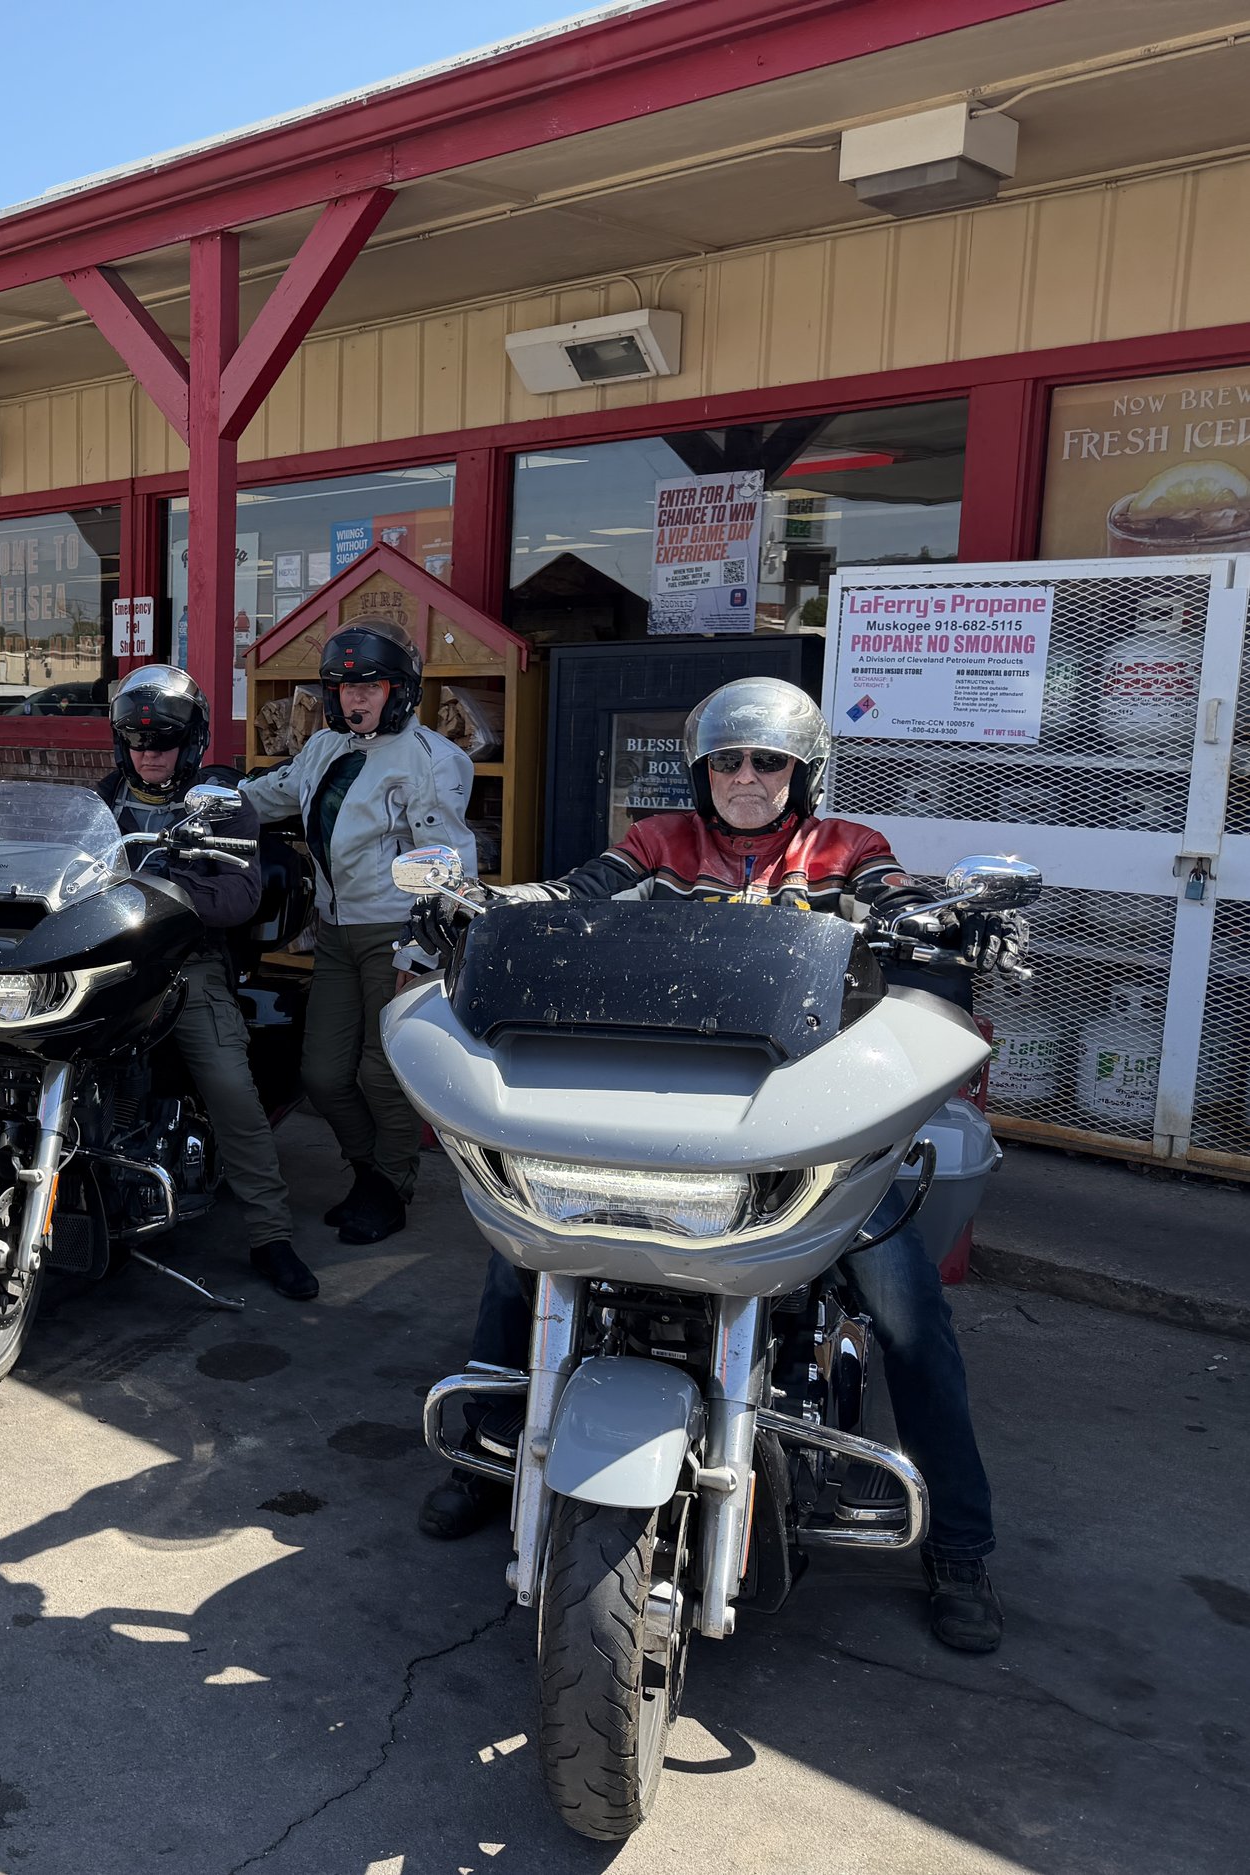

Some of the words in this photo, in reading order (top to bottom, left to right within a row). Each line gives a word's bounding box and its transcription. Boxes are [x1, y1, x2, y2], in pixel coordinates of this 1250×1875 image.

[1113, 394, 1166, 417] NOW
[1062, 426, 1169, 461] FRESH
[658, 487, 697, 508] ENTER
[699, 485, 725, 504] FOR
[726, 484, 735, 503] A
[657, 506, 708, 527] CHANCE
[710, 505, 727, 524] TO
[729, 502, 757, 522] WIN
[656, 528, 665, 546] A
[668, 526, 689, 545] VIP
[690, 524, 725, 543] GAME
[727, 522, 754, 541] DAY
[54, 533, 79, 571] TO
[336, 539, 368, 553] WITHOUT
[655, 543, 730, 564] EXPERIENCE.
[360, 592, 403, 609] FIRE
[849, 595, 946, 618] LaFerry's
[950, 594, 1046, 617] Propane
[114, 603, 151, 615] Emerency
[126, 621, 139, 633] Fel
[866, 620, 931, 633] Muskogee
[935, 620, 1022, 631] 918-682-5115
[137, 640, 145, 652] Off
[851, 634, 923, 653] PROPANE
[927, 634, 949, 653] NO
[954, 635, 1035, 653] SMOKING
[862, 699, 870, 708] 4
[852, 707, 859, 718] 2
[871, 708, 879, 719] 0
[891, 718, 944, 726] ChemTrec-CCN
[627, 738, 686, 752] BLESSI
[648, 761, 681, 775] BOX
[670, 778, 682, 786] you
[672, 788, 685, 796] you
[623, 796, 670, 808] ABOVE
[677, 798, 696, 809] AL
